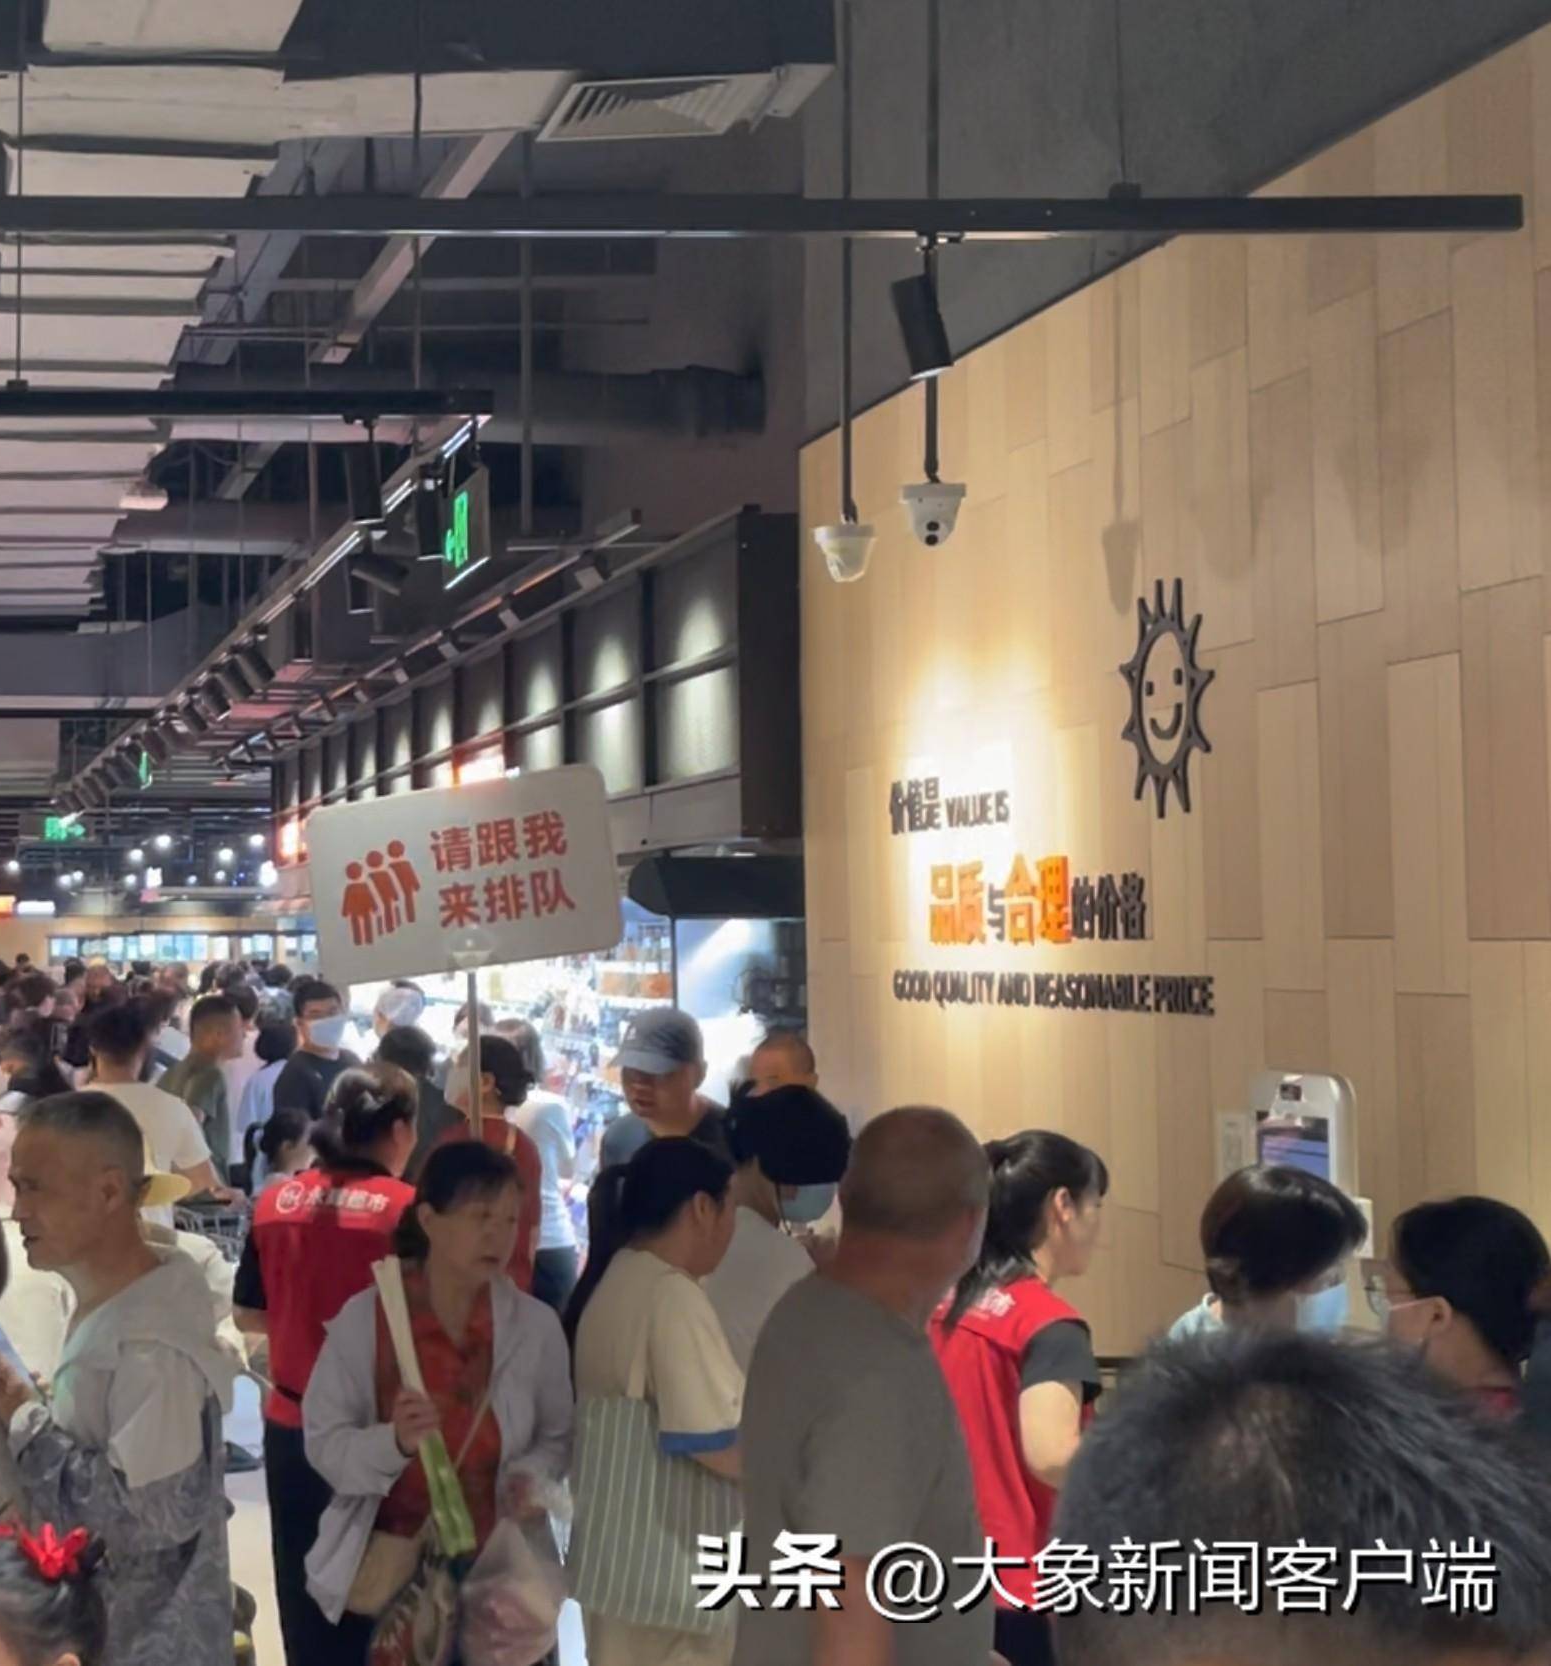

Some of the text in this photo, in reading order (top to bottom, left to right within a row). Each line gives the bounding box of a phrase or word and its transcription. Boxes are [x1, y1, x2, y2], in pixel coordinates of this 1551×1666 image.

[945, 792, 993, 828] VALUE
[430, 810, 567, 872] 请跟我
[438, 867, 576, 928] 来排队
[929, 854, 1148, 945] 品质与合理的价格
[893, 969, 1216, 1017] GOOD QUALITY AND REASONABLE PRICE
